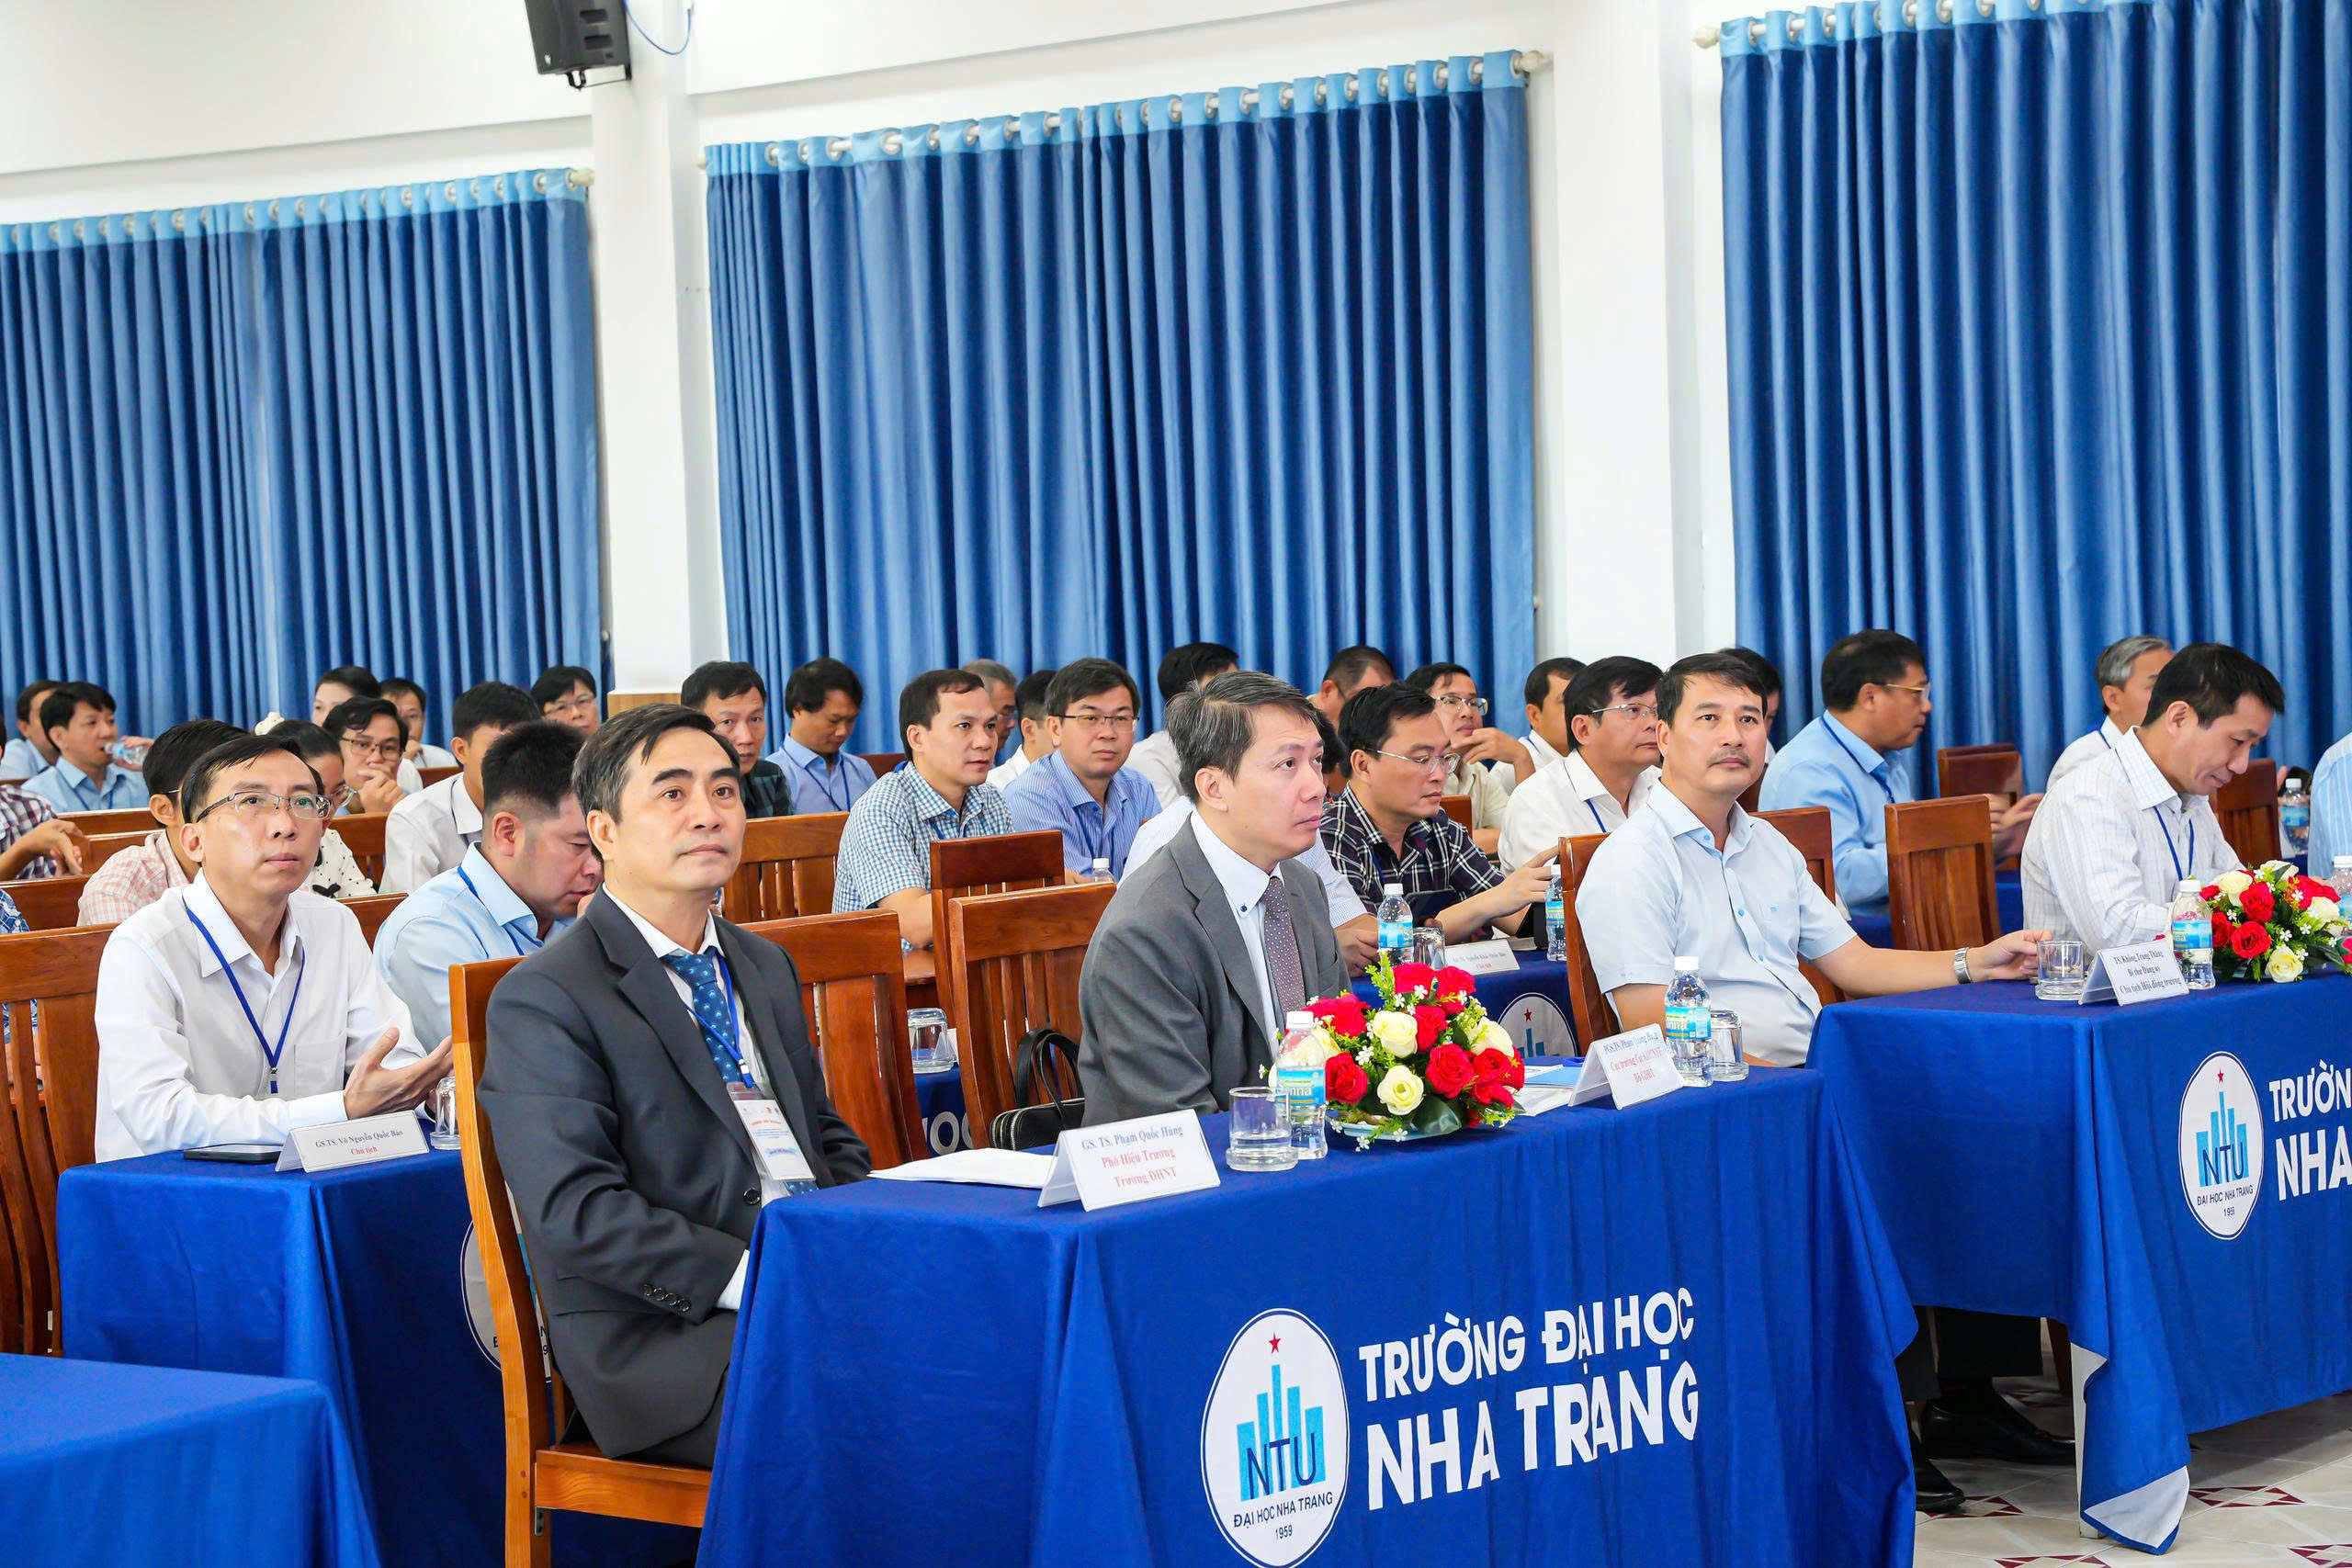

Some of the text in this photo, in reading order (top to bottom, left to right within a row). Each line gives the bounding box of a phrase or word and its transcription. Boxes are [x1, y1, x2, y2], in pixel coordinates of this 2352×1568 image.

[2268, 1059, 2352, 1122] TRƯỜN
[2202, 1142, 2244, 1187] NTU
[2275, 1125, 2352, 1201] NHA
[2224, 1190, 2236, 1201] NHA
[1359, 1287, 1694, 1402] TRƯỜNG ĐẠI HỌC
[1246, 1432, 1317, 1500] NTU
[1366, 1360, 1700, 1511] NHA TRANG
[1233, 1491, 1333, 1529] ĐẠI HỌC NHA TRANG
[1275, 1524, 1293, 1540] 1959
